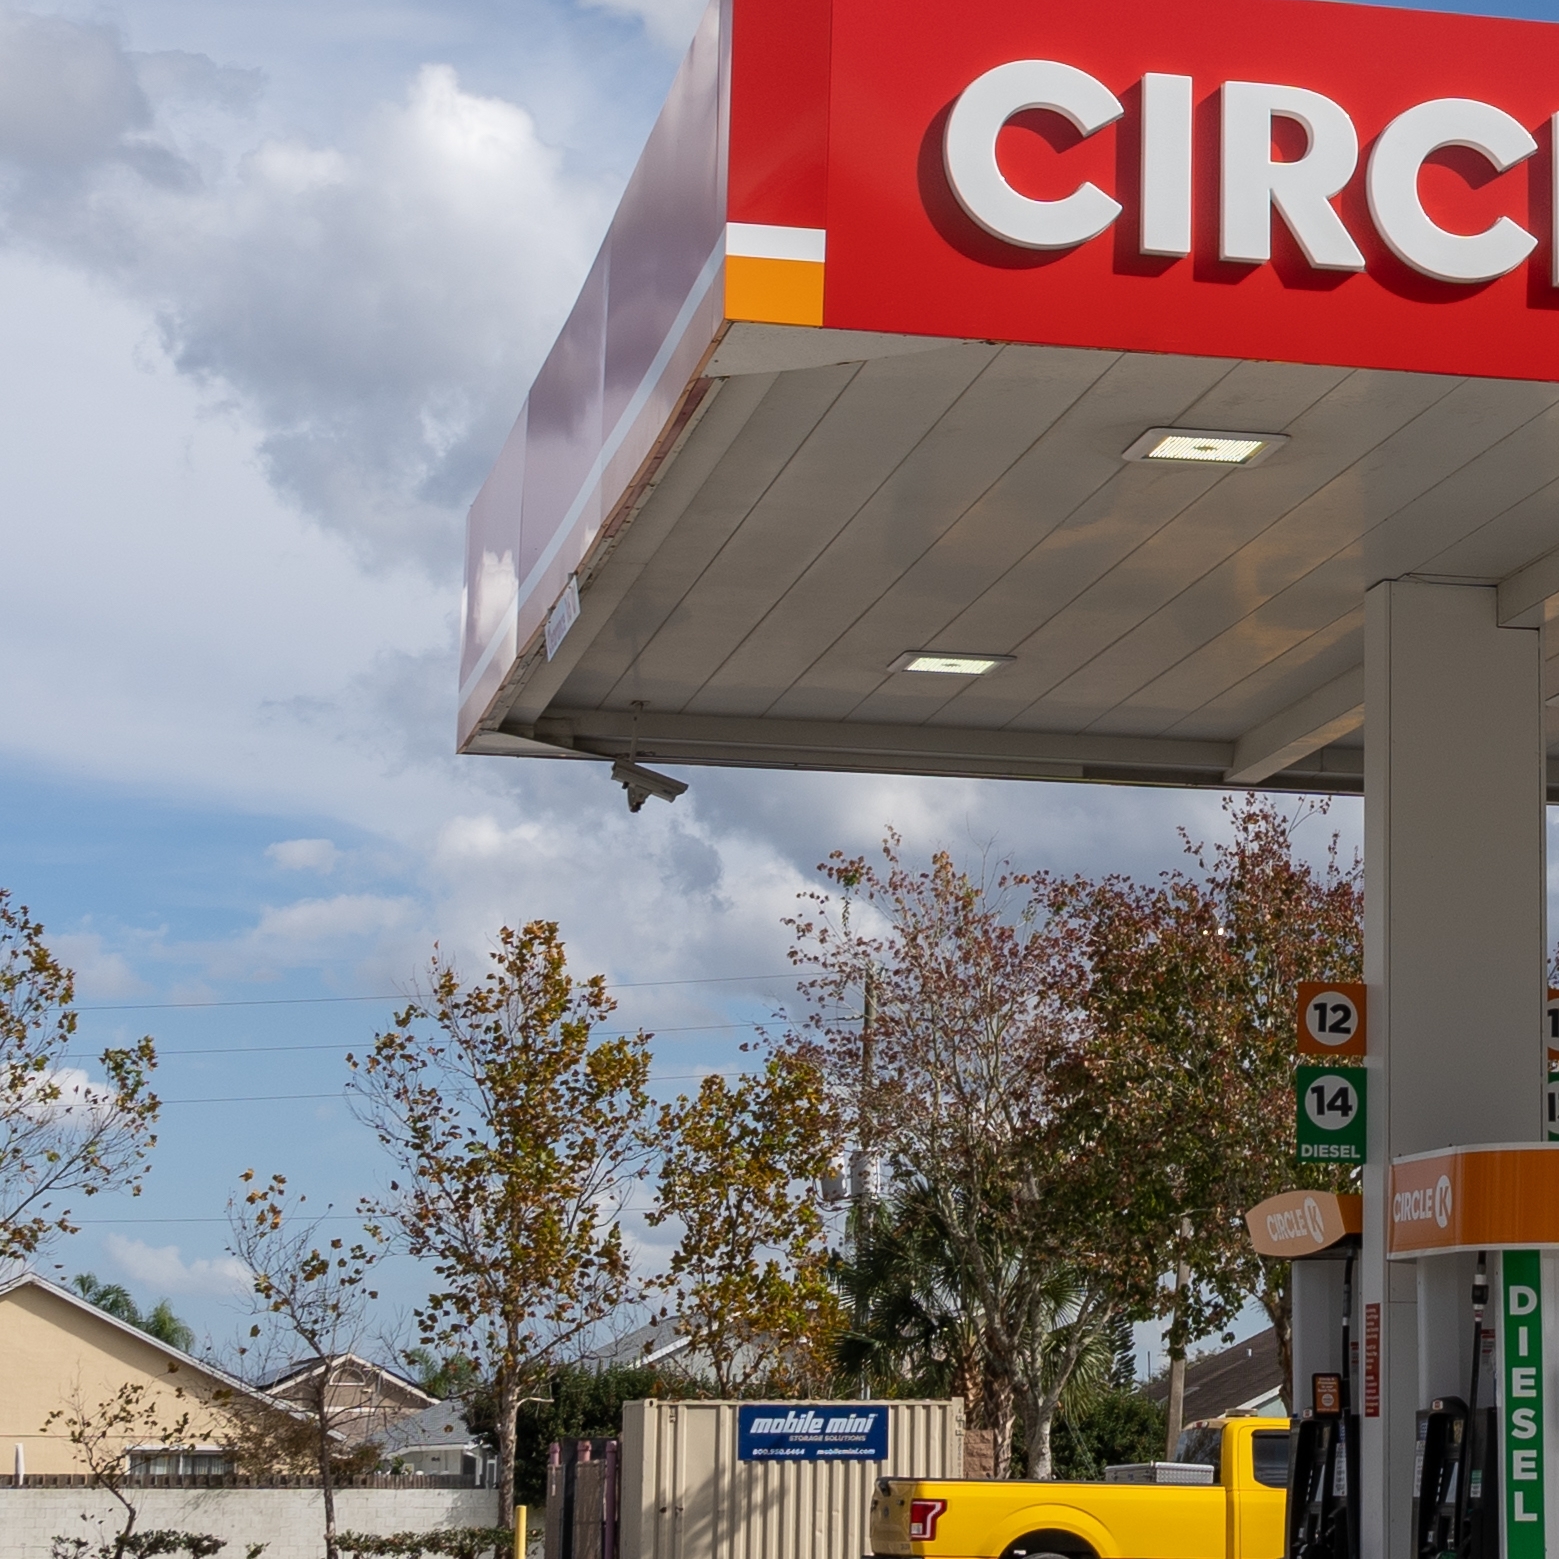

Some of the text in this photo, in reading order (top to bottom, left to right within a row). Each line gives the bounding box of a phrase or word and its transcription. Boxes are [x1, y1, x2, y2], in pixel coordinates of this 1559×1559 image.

[1313, 1002, 1352, 1035] 12
[1310, 1084, 1353, 1117] 14
[1301, 1144, 1361, 1159] DIESEL
[1393, 1188, 1433, 1223] CIRCLE
[1266, 1208, 1308, 1242] CIRCLE
[1509, 1285, 1538, 1522] DIESEL
[750, 1410, 876, 1434] mobile mini
